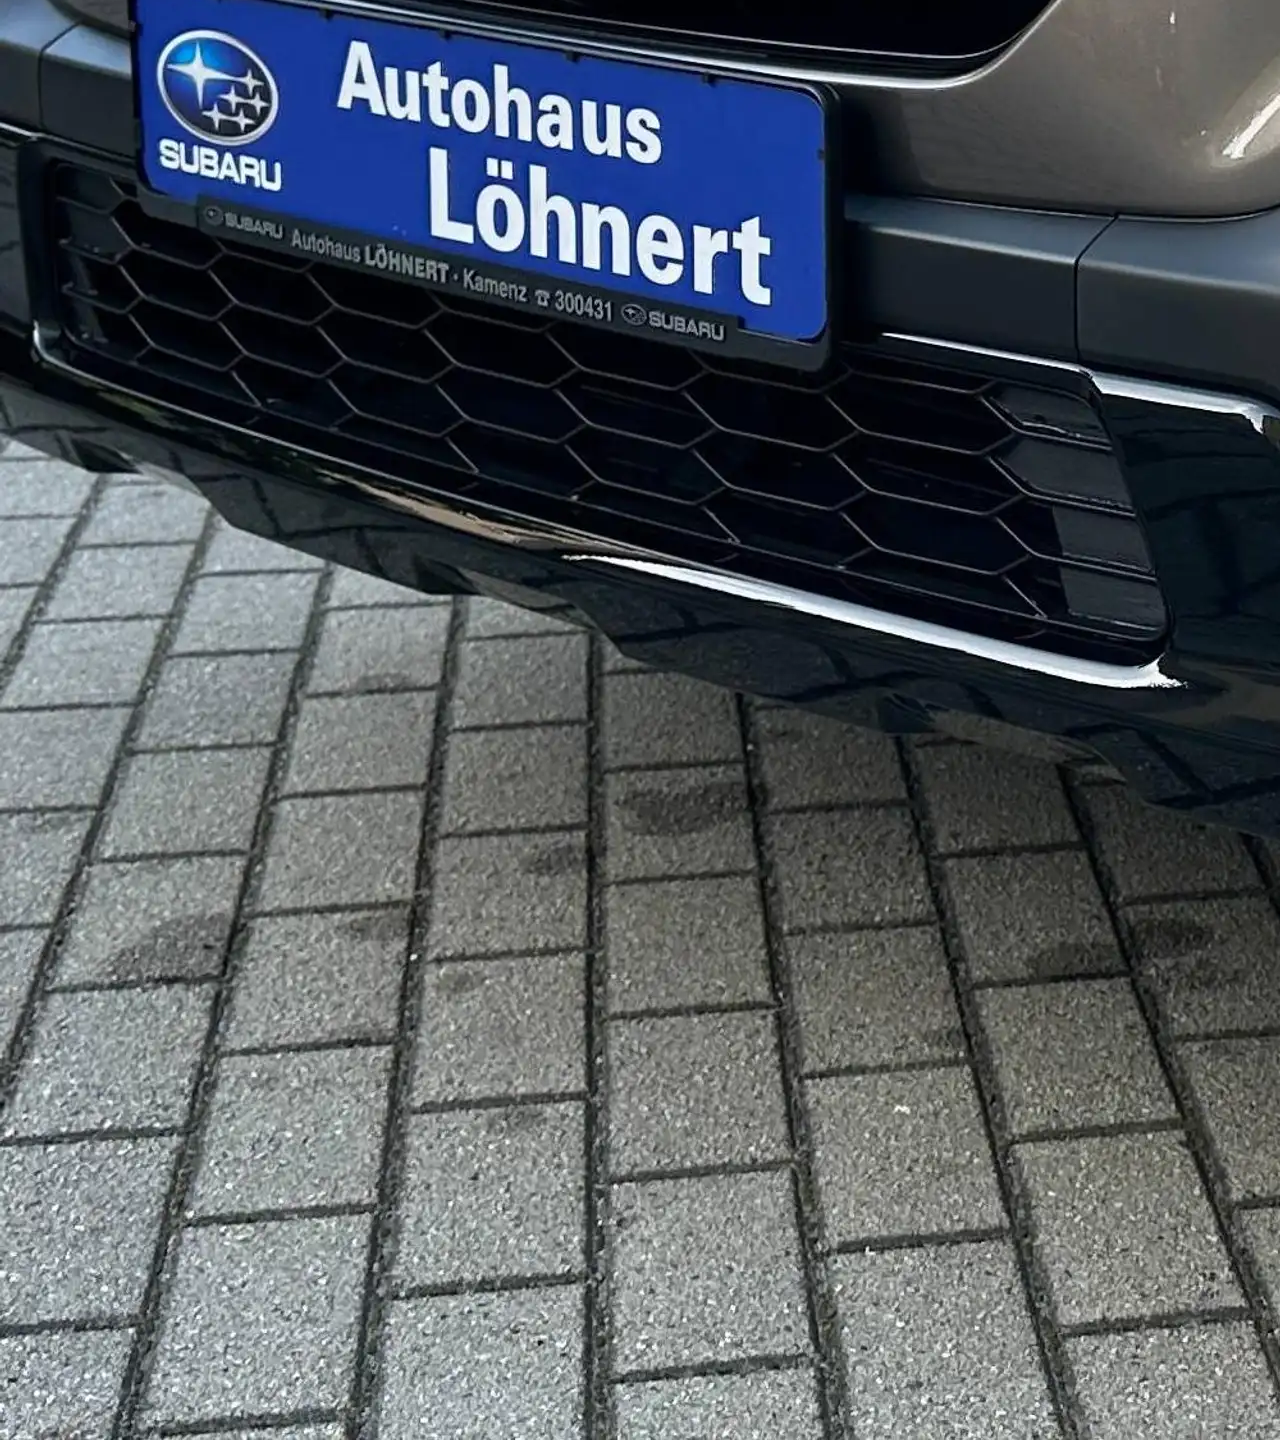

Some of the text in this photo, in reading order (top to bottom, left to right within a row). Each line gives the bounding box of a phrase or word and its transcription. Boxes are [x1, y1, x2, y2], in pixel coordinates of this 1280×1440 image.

[159, 138, 282, 192] SUBARU
[336, 40, 663, 164] Autohaus
[224, 212, 725, 342] SUBARU Autohaus LÖHNERT Kamenz 300431 SUBARU
[428, 146, 771, 306] Löhnert
